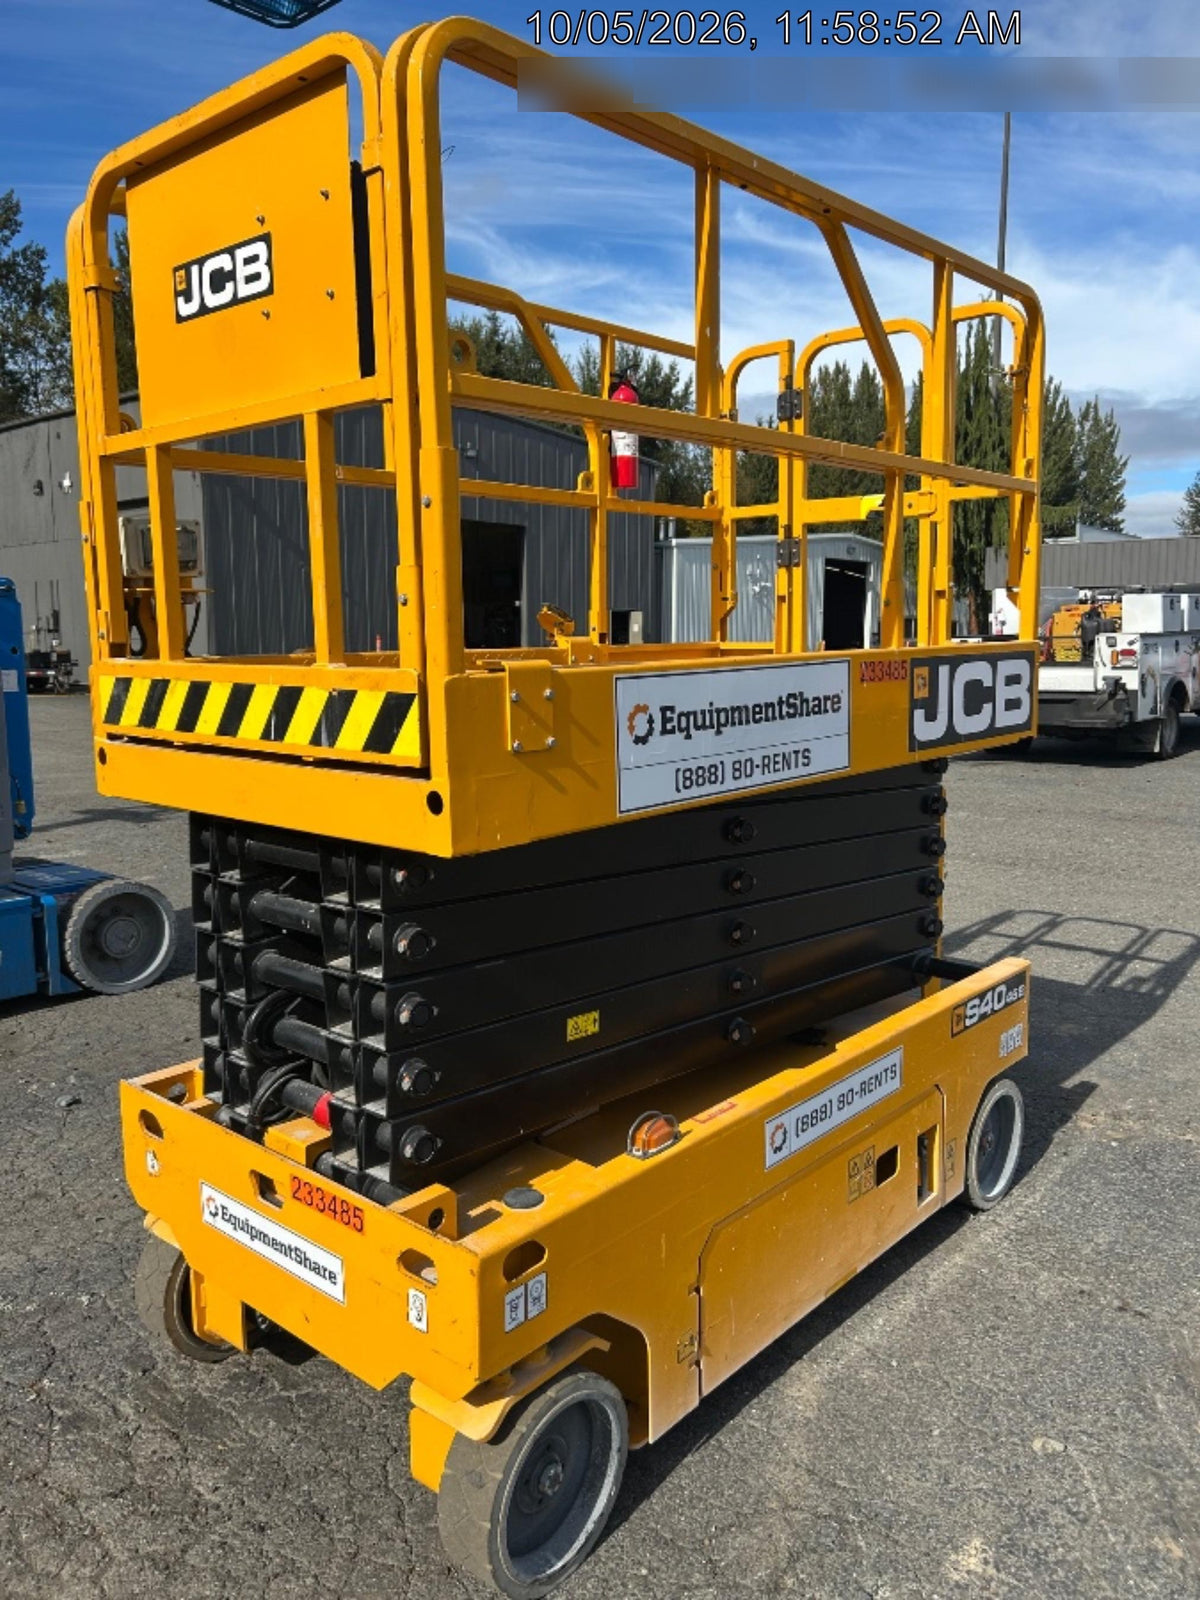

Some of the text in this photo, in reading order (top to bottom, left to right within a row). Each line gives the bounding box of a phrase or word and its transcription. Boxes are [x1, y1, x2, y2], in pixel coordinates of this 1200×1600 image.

[177, 240, 271, 317] JCB
[659, 691, 842, 740] EquipmentShare
[913, 658, 1031, 742] JCB
[675, 748, 812, 793] (888) 80-RENTS
[795, 1062, 897, 1138] (888) 80-RENTS
[292, 1176, 364, 1233] 233485
[220, 1204, 338, 1286] EquipmentShare
